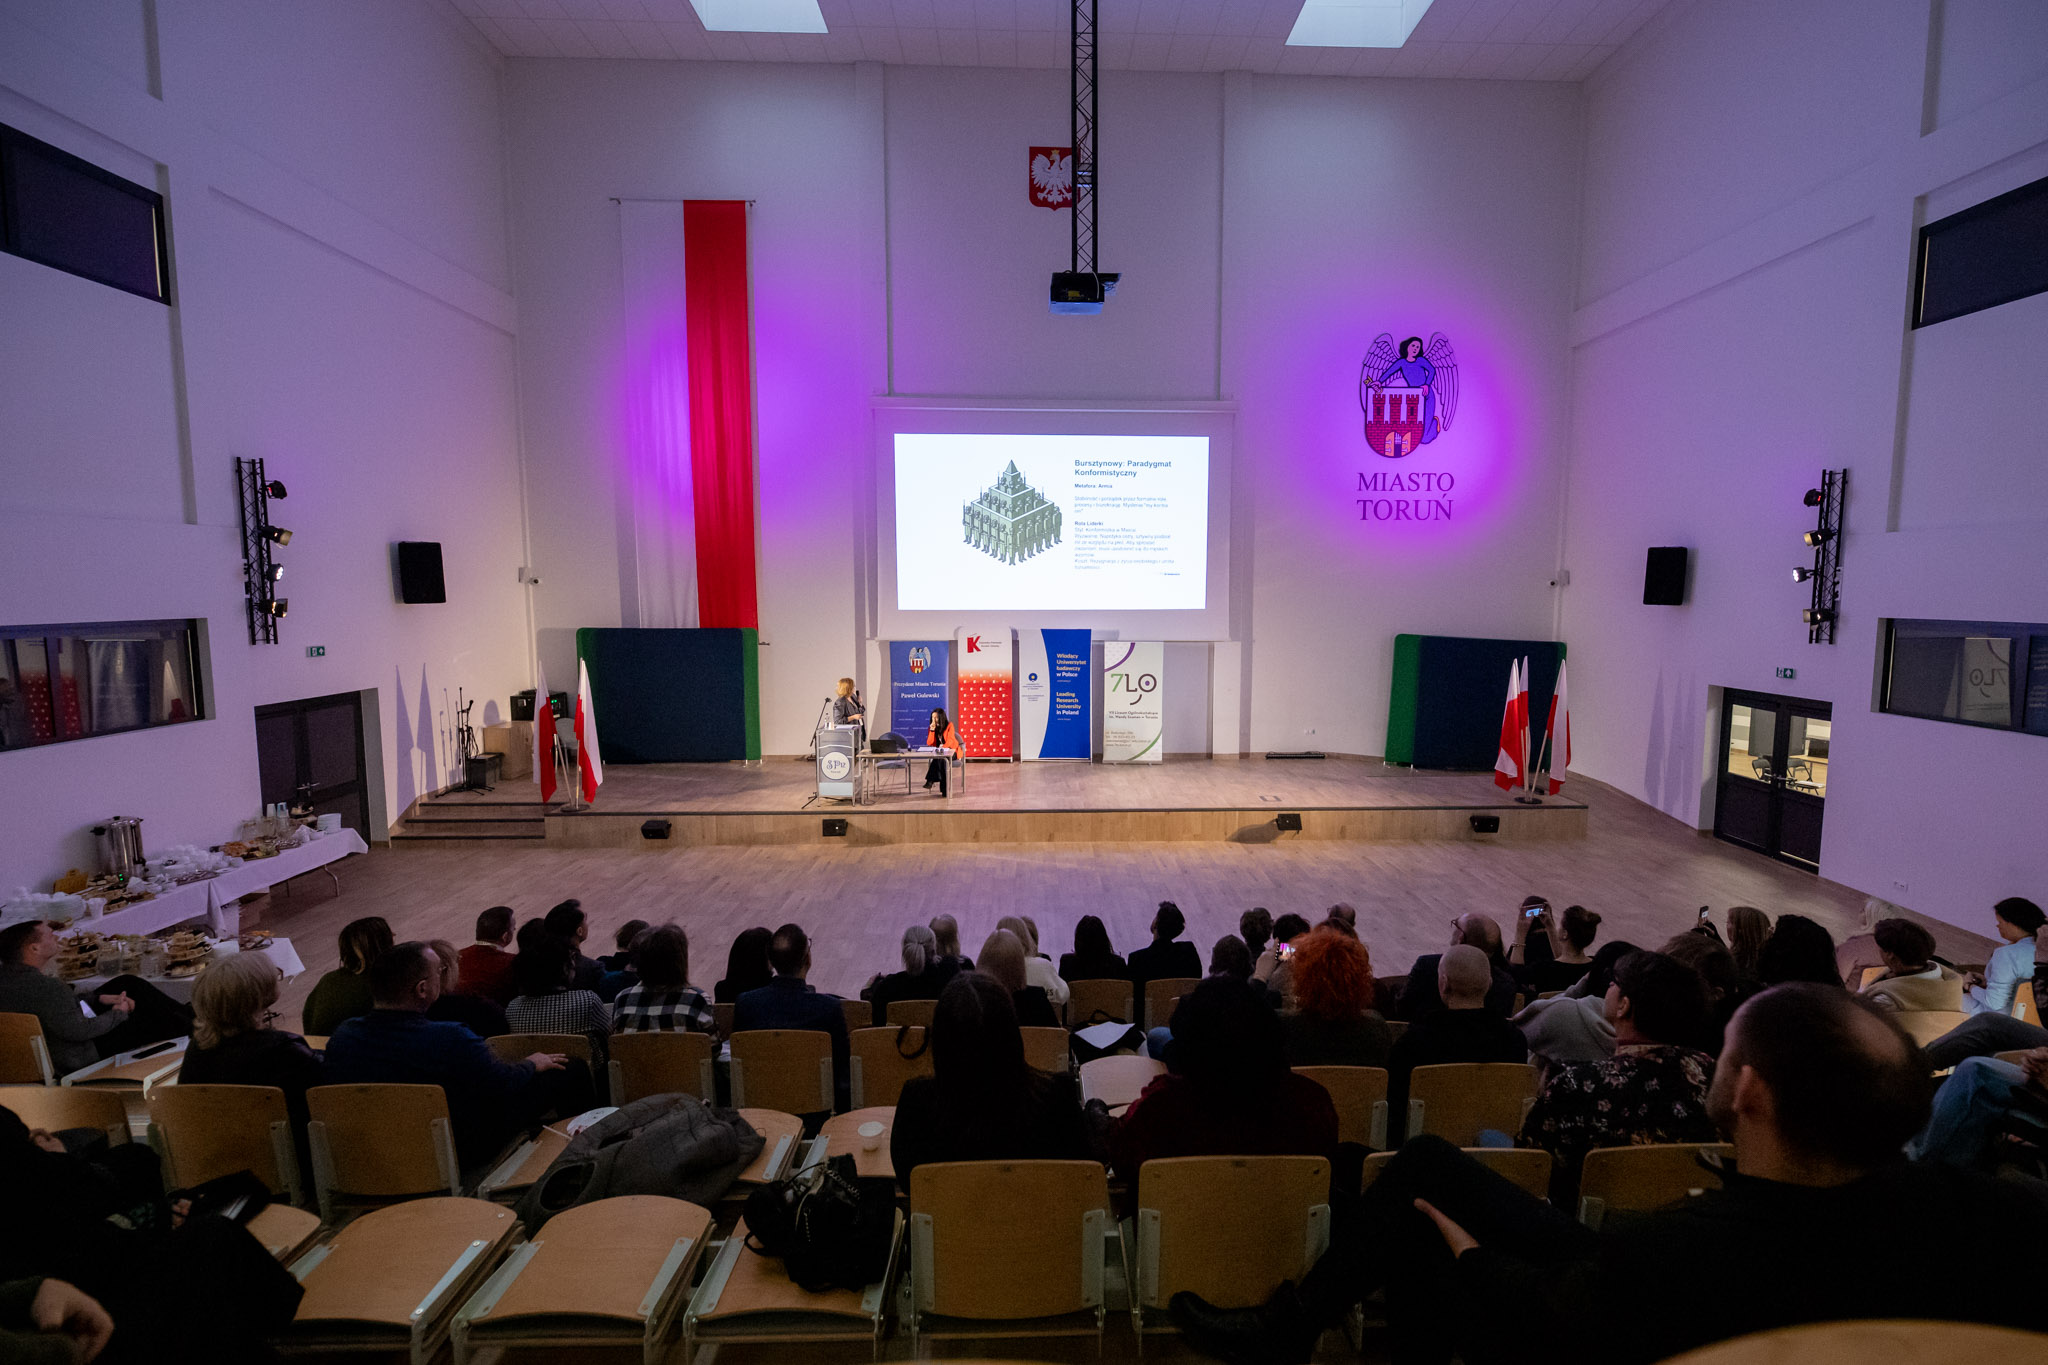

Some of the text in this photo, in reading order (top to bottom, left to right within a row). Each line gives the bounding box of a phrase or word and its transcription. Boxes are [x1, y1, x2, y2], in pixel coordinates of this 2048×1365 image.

[1074, 459, 1172, 469] Bursztynowy: Paradygmat
[1074, 469, 1137, 478] Konformistyczny
[1356, 472, 1455, 492] MIASTO
[1356, 493, 1454, 521] TORUŃ
[1110, 673, 1157, 693] 7LO
